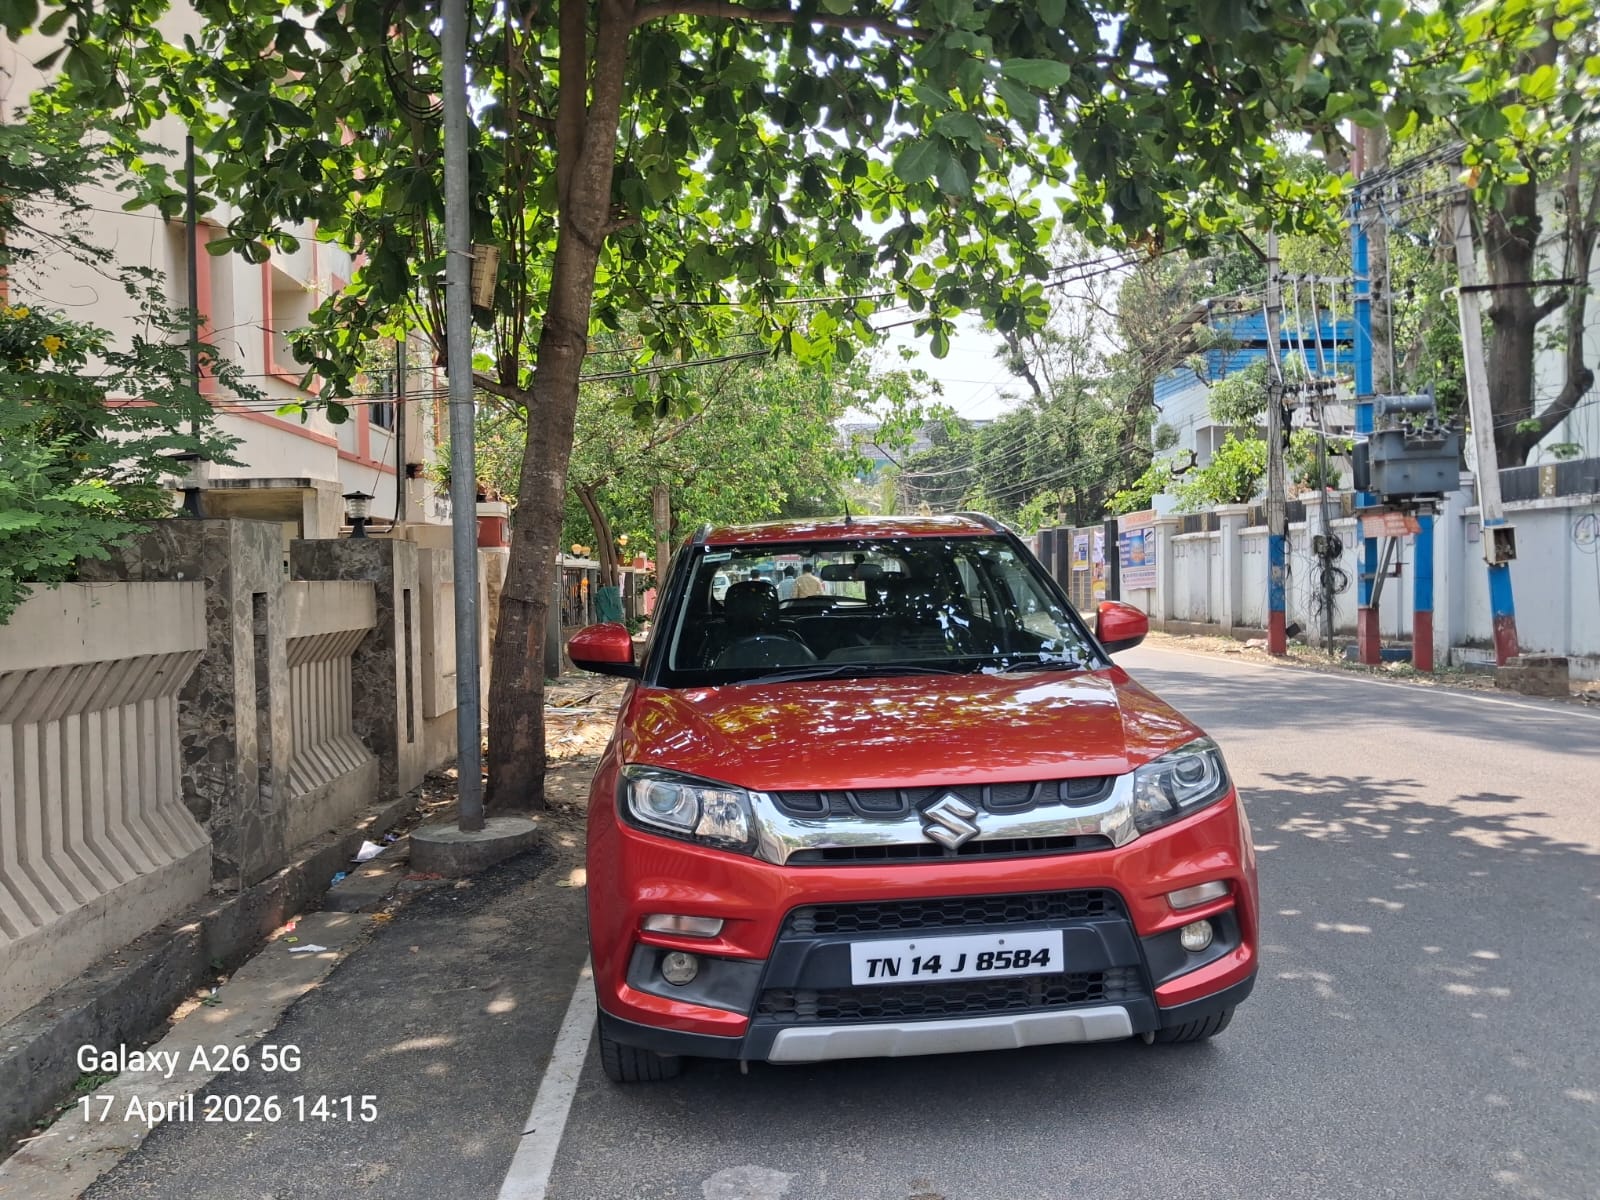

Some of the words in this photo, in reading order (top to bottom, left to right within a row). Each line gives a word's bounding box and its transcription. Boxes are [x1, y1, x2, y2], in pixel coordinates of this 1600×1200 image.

[866, 958, 902, 978] TN
[911, 954, 942, 975] 14
[950, 953, 967, 973] J
[975, 948, 1051, 971] 8584
